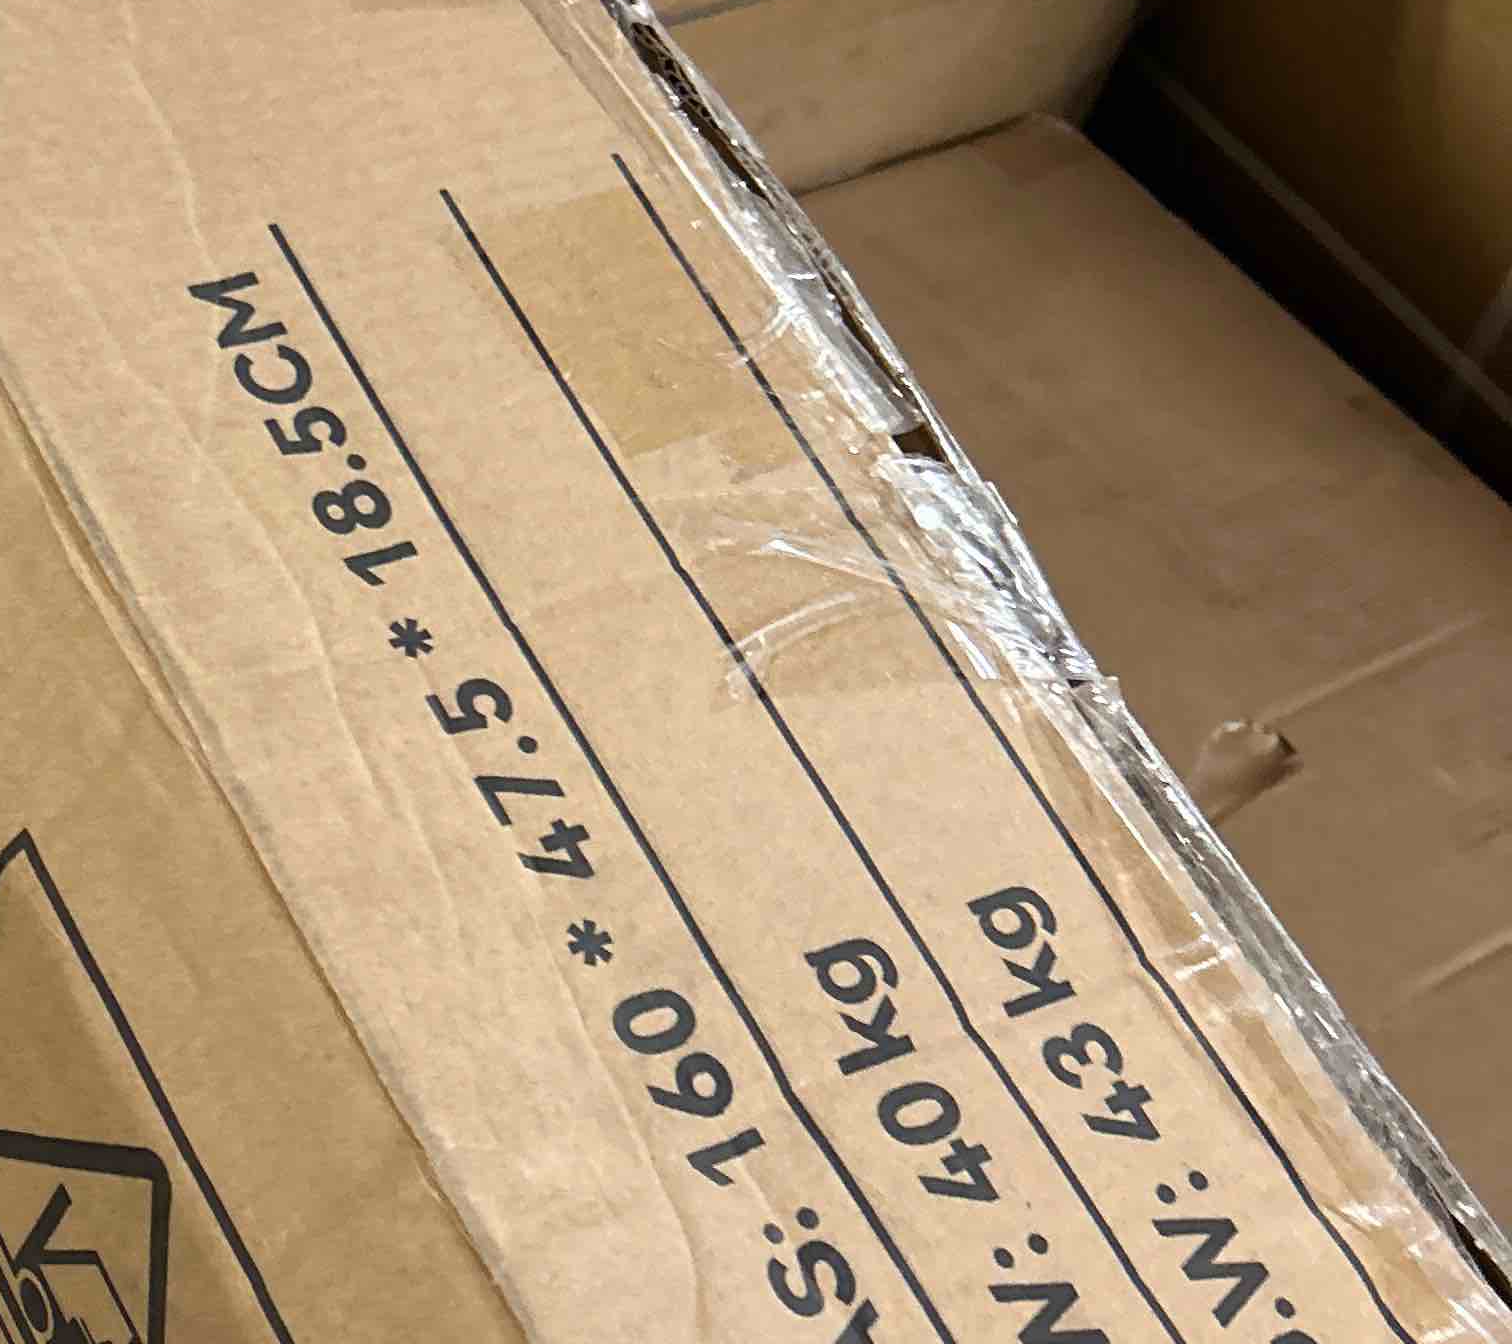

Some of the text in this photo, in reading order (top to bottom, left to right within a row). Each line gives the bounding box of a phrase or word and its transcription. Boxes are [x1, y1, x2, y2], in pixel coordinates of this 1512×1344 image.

[188, 271, 418, 587] 18.5CM
[425, 677, 598, 881] 47.5
[612, 987, 766, 1186] 160
